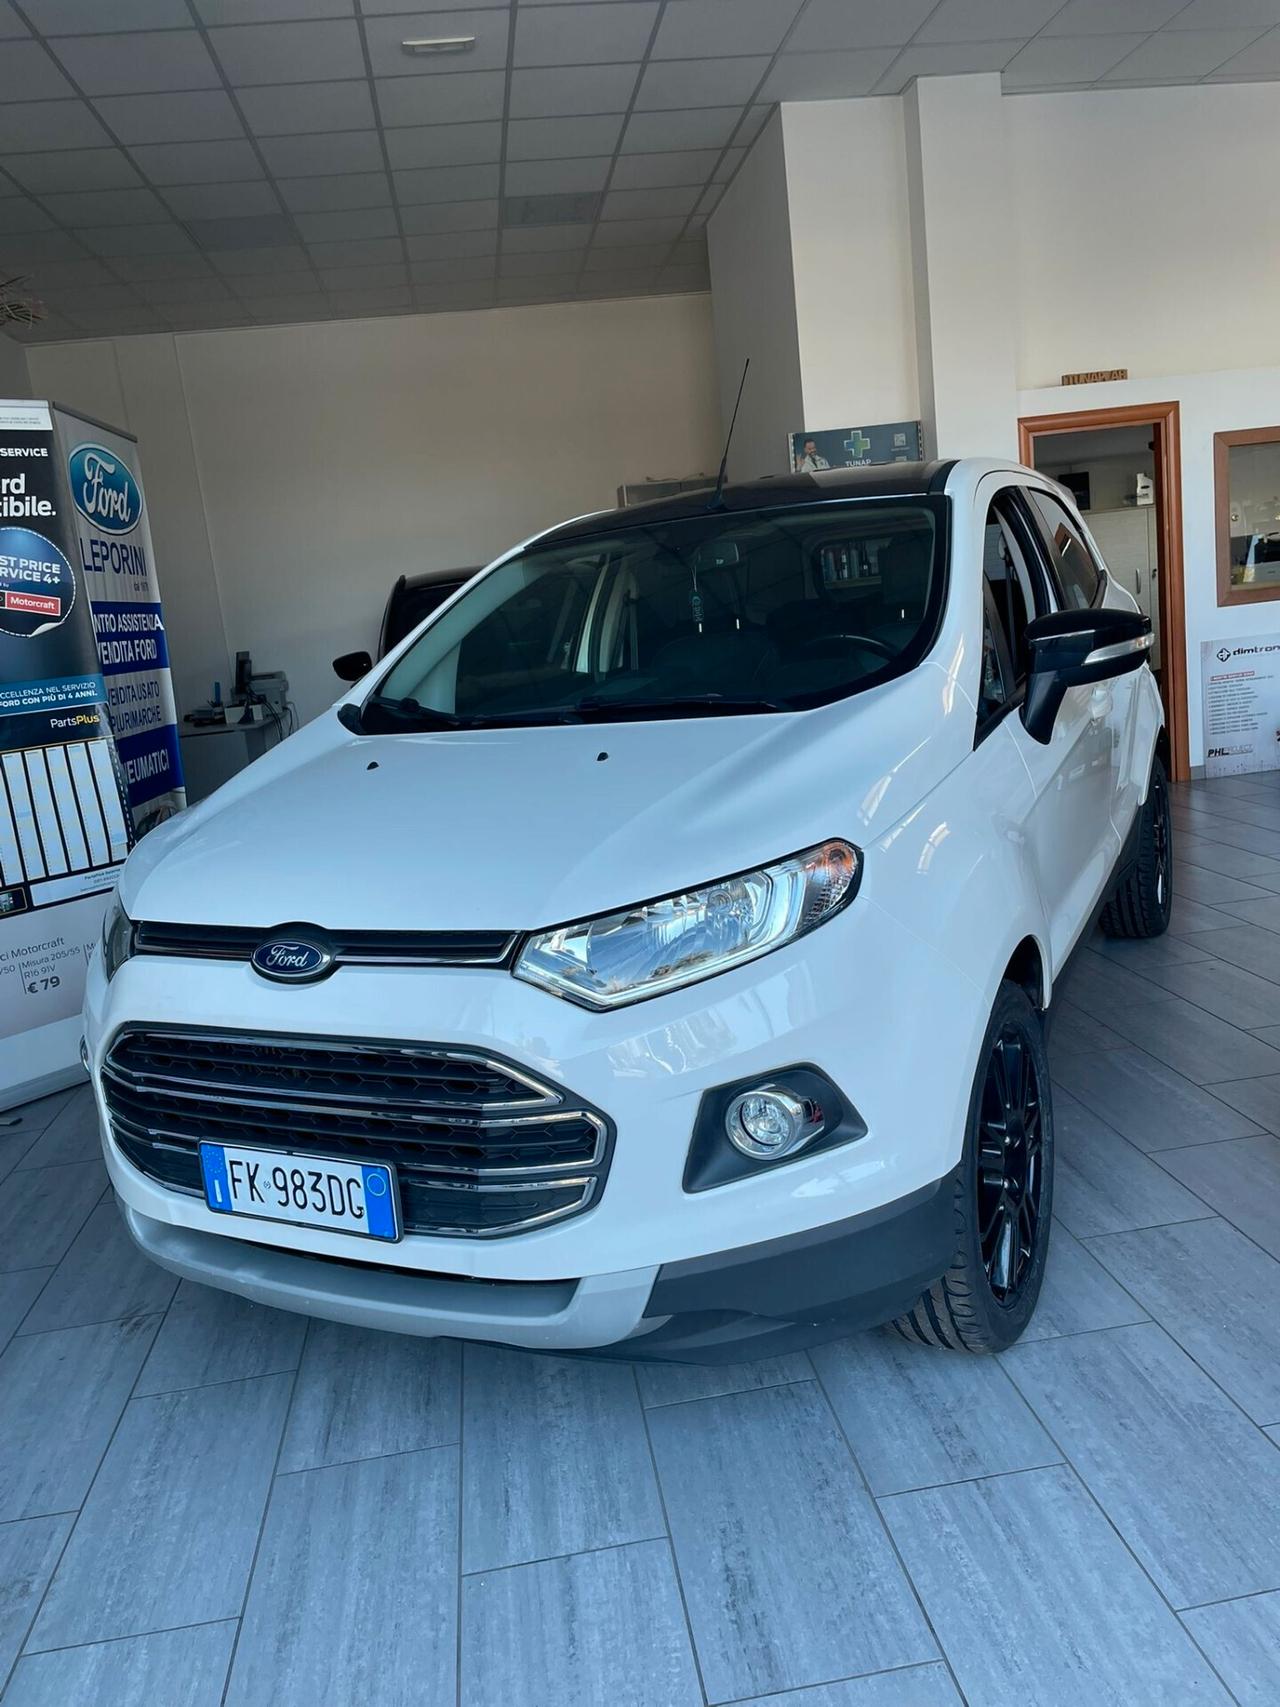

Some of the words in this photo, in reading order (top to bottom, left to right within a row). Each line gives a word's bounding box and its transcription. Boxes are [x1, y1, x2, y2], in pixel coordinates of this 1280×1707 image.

[0, 448, 48, 457] SERVICE
[83, 452, 131, 522] Ford
[20, 558, 60, 574] PRICE
[80, 537, 147, 577] LEPORINI
[43, 573, 61, 584] 4+
[11, 597, 55, 610] Motorcraft
[134, 638, 158, 661] FORD
[22, 697, 40, 705] CON
[42, 693, 57, 703] PIÙ
[59, 693, 66, 701] DI
[75, 690, 98, 699] ANNI.
[46, 686, 60, 694] NEL
[62, 682, 96, 692] SERVIZIO
[136, 681, 160, 700] USATO
[50, 714, 100, 728] PartsPlus
[11, 937, 65, 958] Motorcraft
[22, 957, 49, 968] Misura
[50, 946, 80, 961] 205/55
[266, 944, 309, 967] Ford
[24, 971, 39, 979] R16
[28, 981, 38, 994] €
[40, 975, 60, 990] 79
[229, 1160, 264, 1203] FK
[272, 1167, 365, 1219] 983DG
